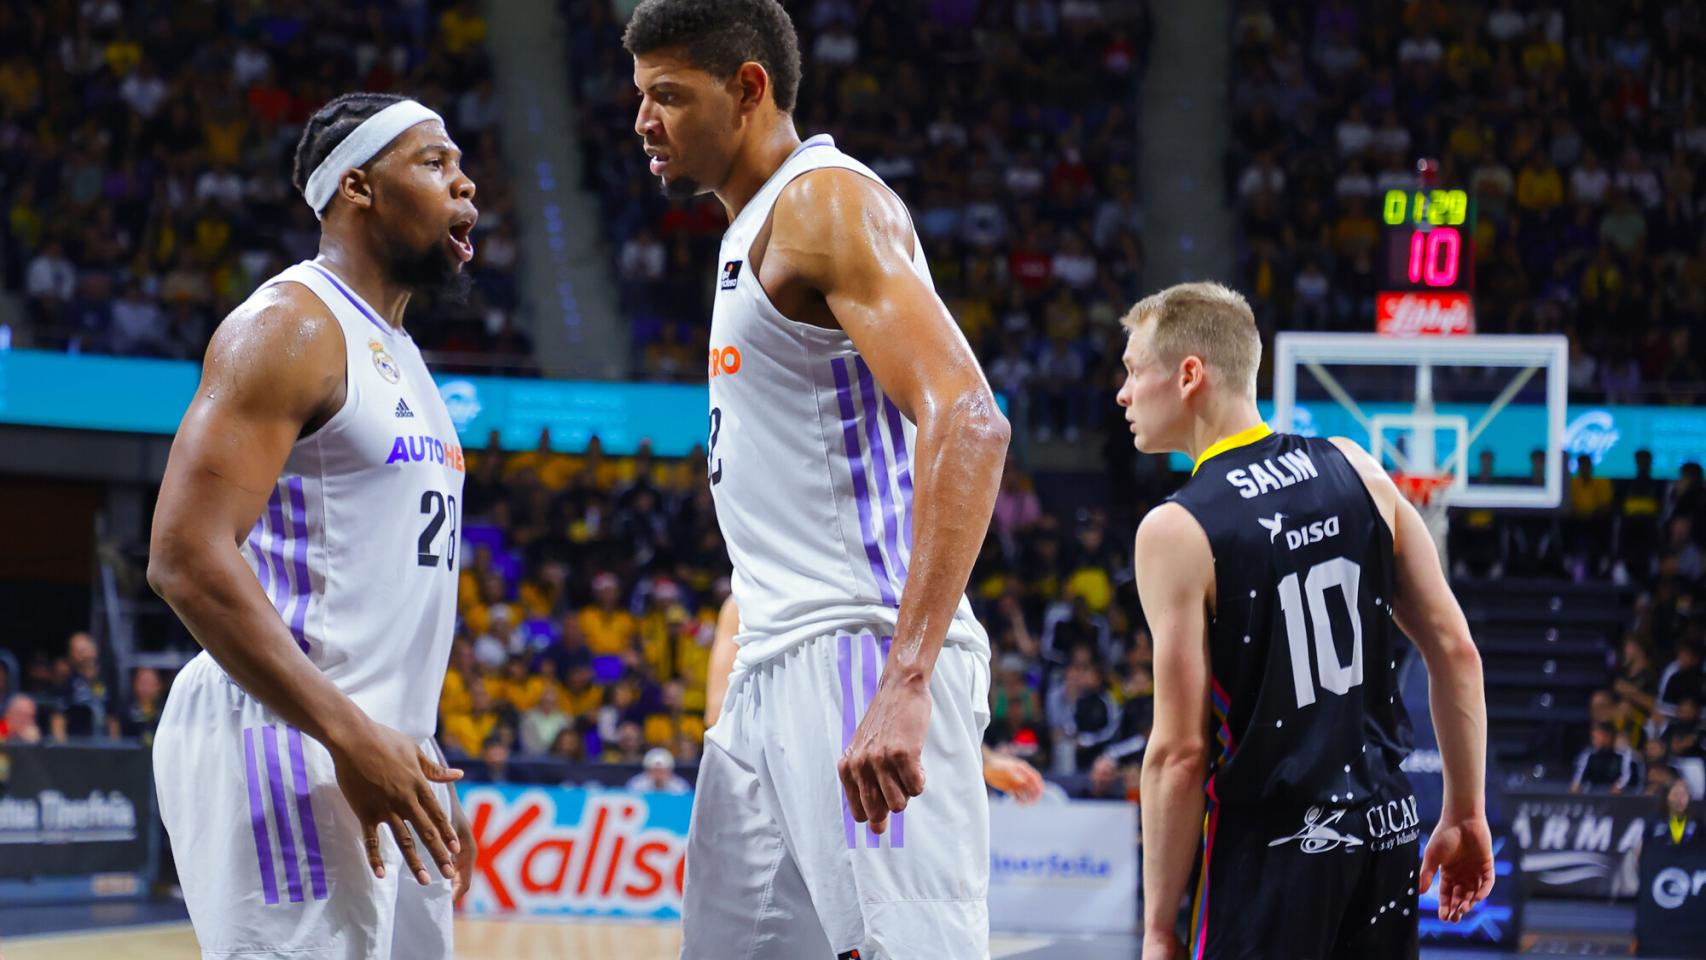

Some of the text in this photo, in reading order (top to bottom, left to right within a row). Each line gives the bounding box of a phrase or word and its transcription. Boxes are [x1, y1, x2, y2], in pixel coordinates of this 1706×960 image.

[1408, 227, 1460, 287] 10
[1226, 448, 1318, 499] SALIN
[1277, 556, 1364, 709] 10
[455, 802, 686, 912] Kalis
